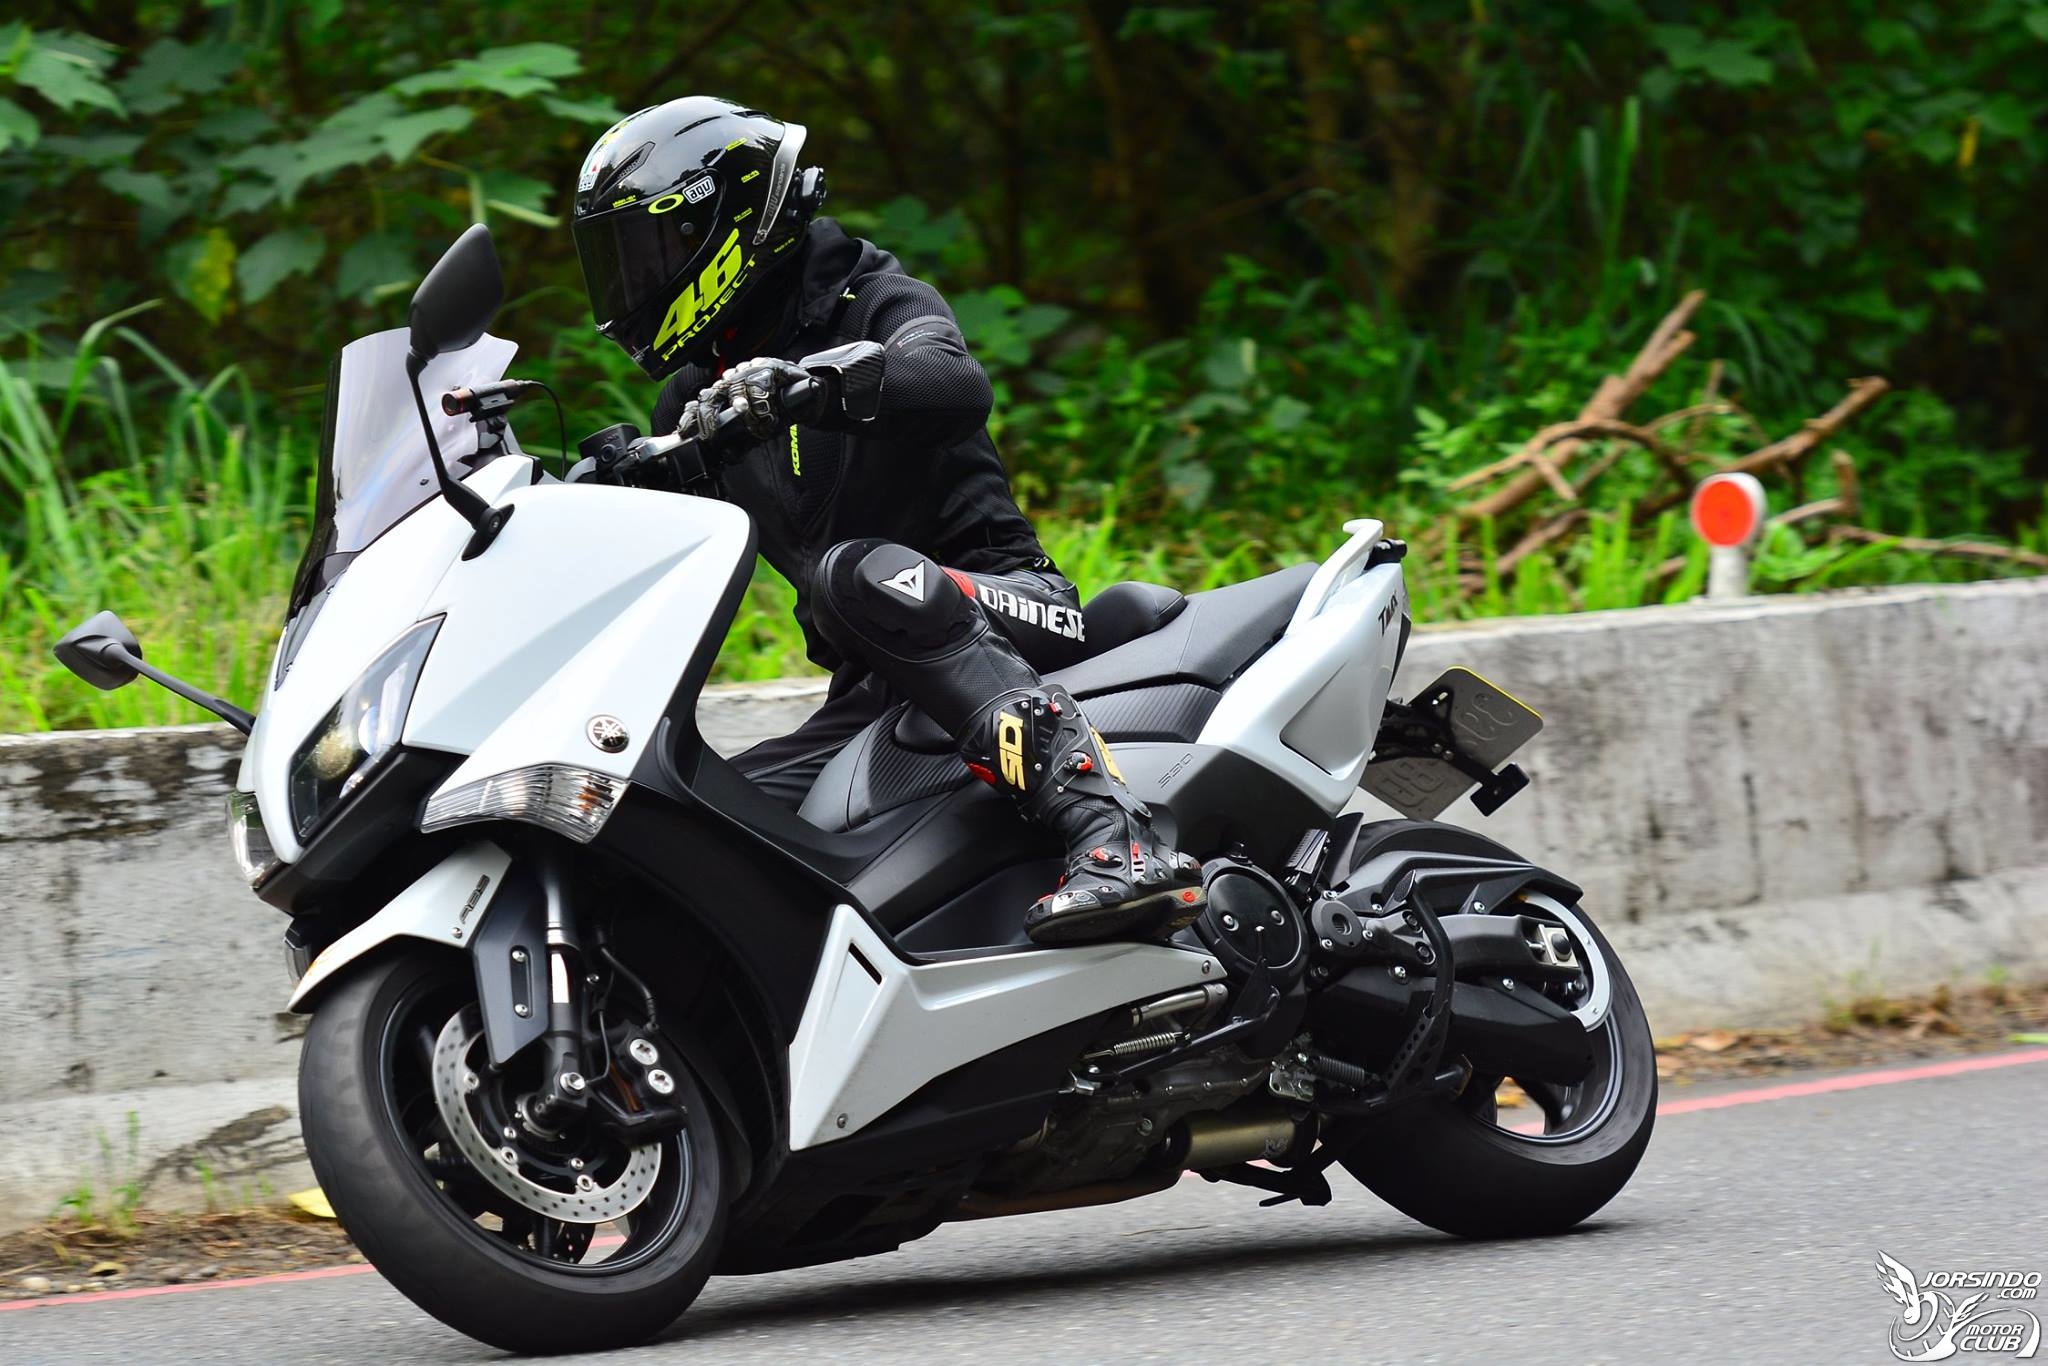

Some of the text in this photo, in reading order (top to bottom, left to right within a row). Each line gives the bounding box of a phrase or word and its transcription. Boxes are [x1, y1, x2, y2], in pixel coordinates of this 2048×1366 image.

[687, 179, 712, 200] agv
[653, 228, 742, 351] 46
[661, 254, 756, 361] PROJECT
